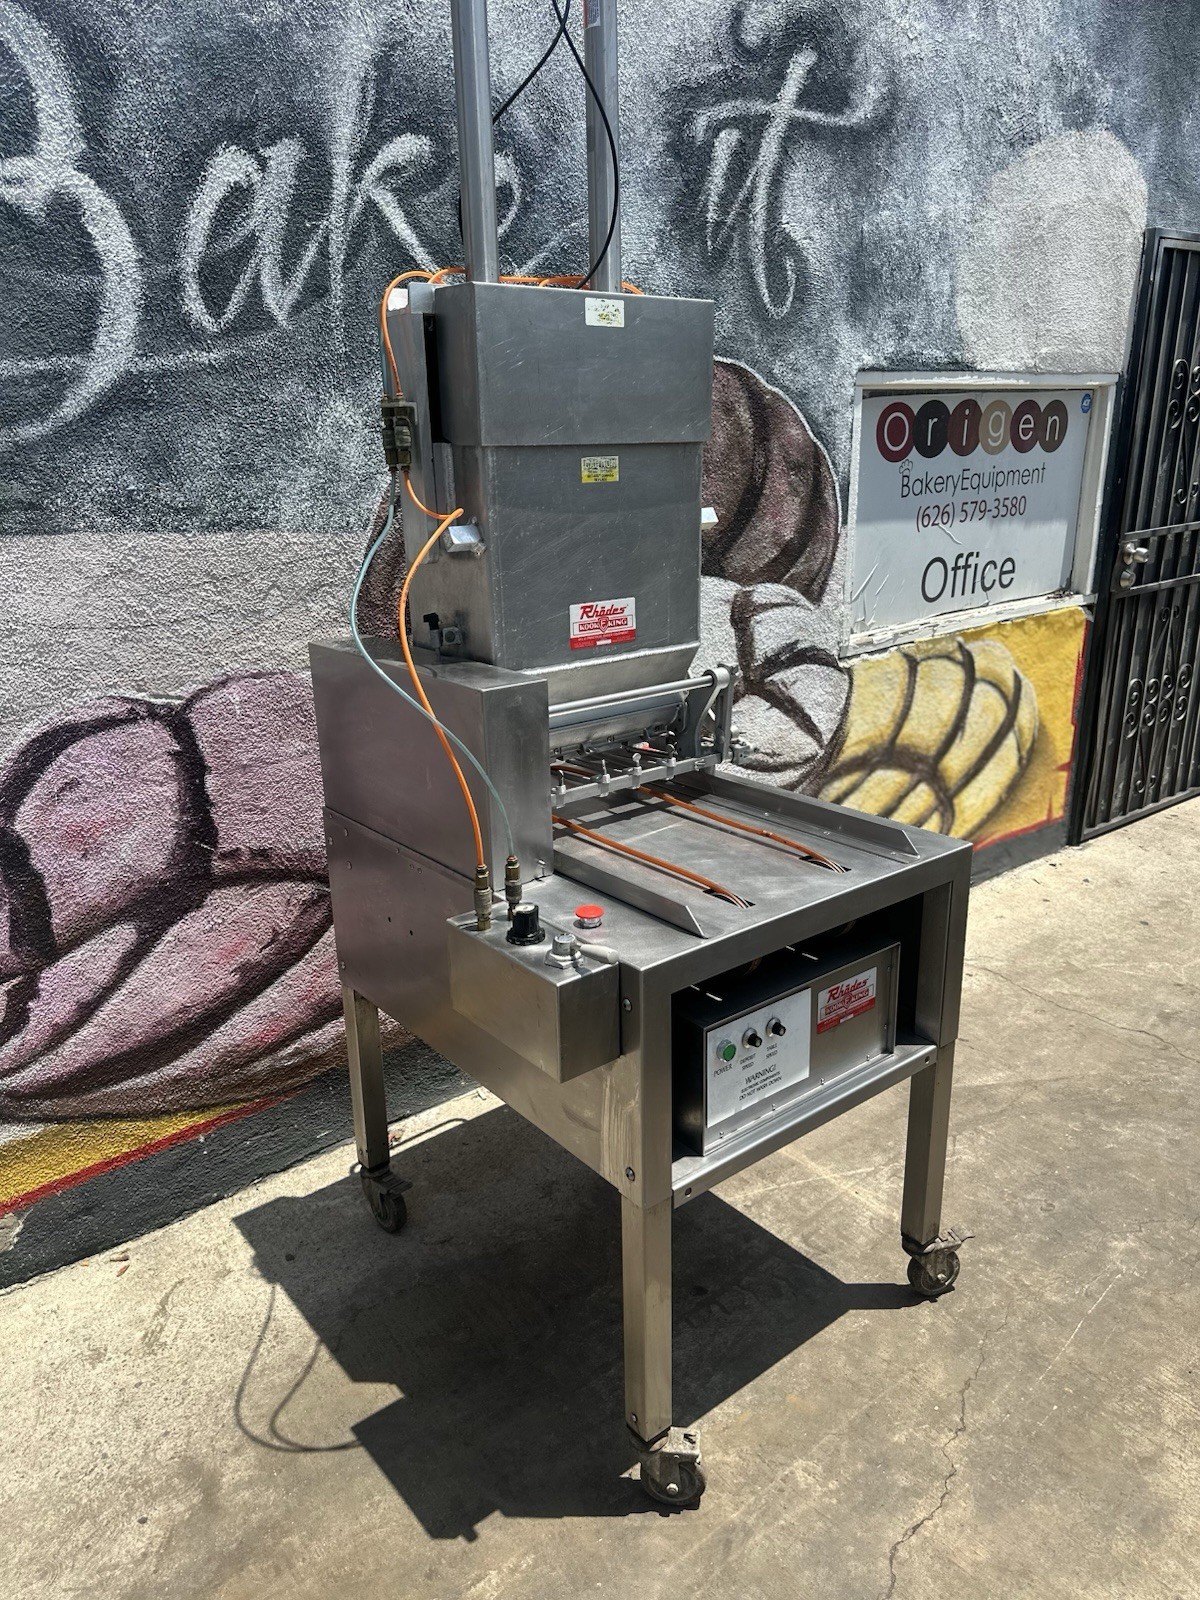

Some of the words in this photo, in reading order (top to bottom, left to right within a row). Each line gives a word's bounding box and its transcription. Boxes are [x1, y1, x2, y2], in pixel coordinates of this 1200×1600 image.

[883, 408, 1061, 452] Origen
[916, 501, 956, 532] (626)
[959, 495, 1027, 523] 579-3580
[921, 551, 1017, 603] Office
[713, 1063, 733, 1078] POWER
[745, 1064, 777, 1085] WARNING!
